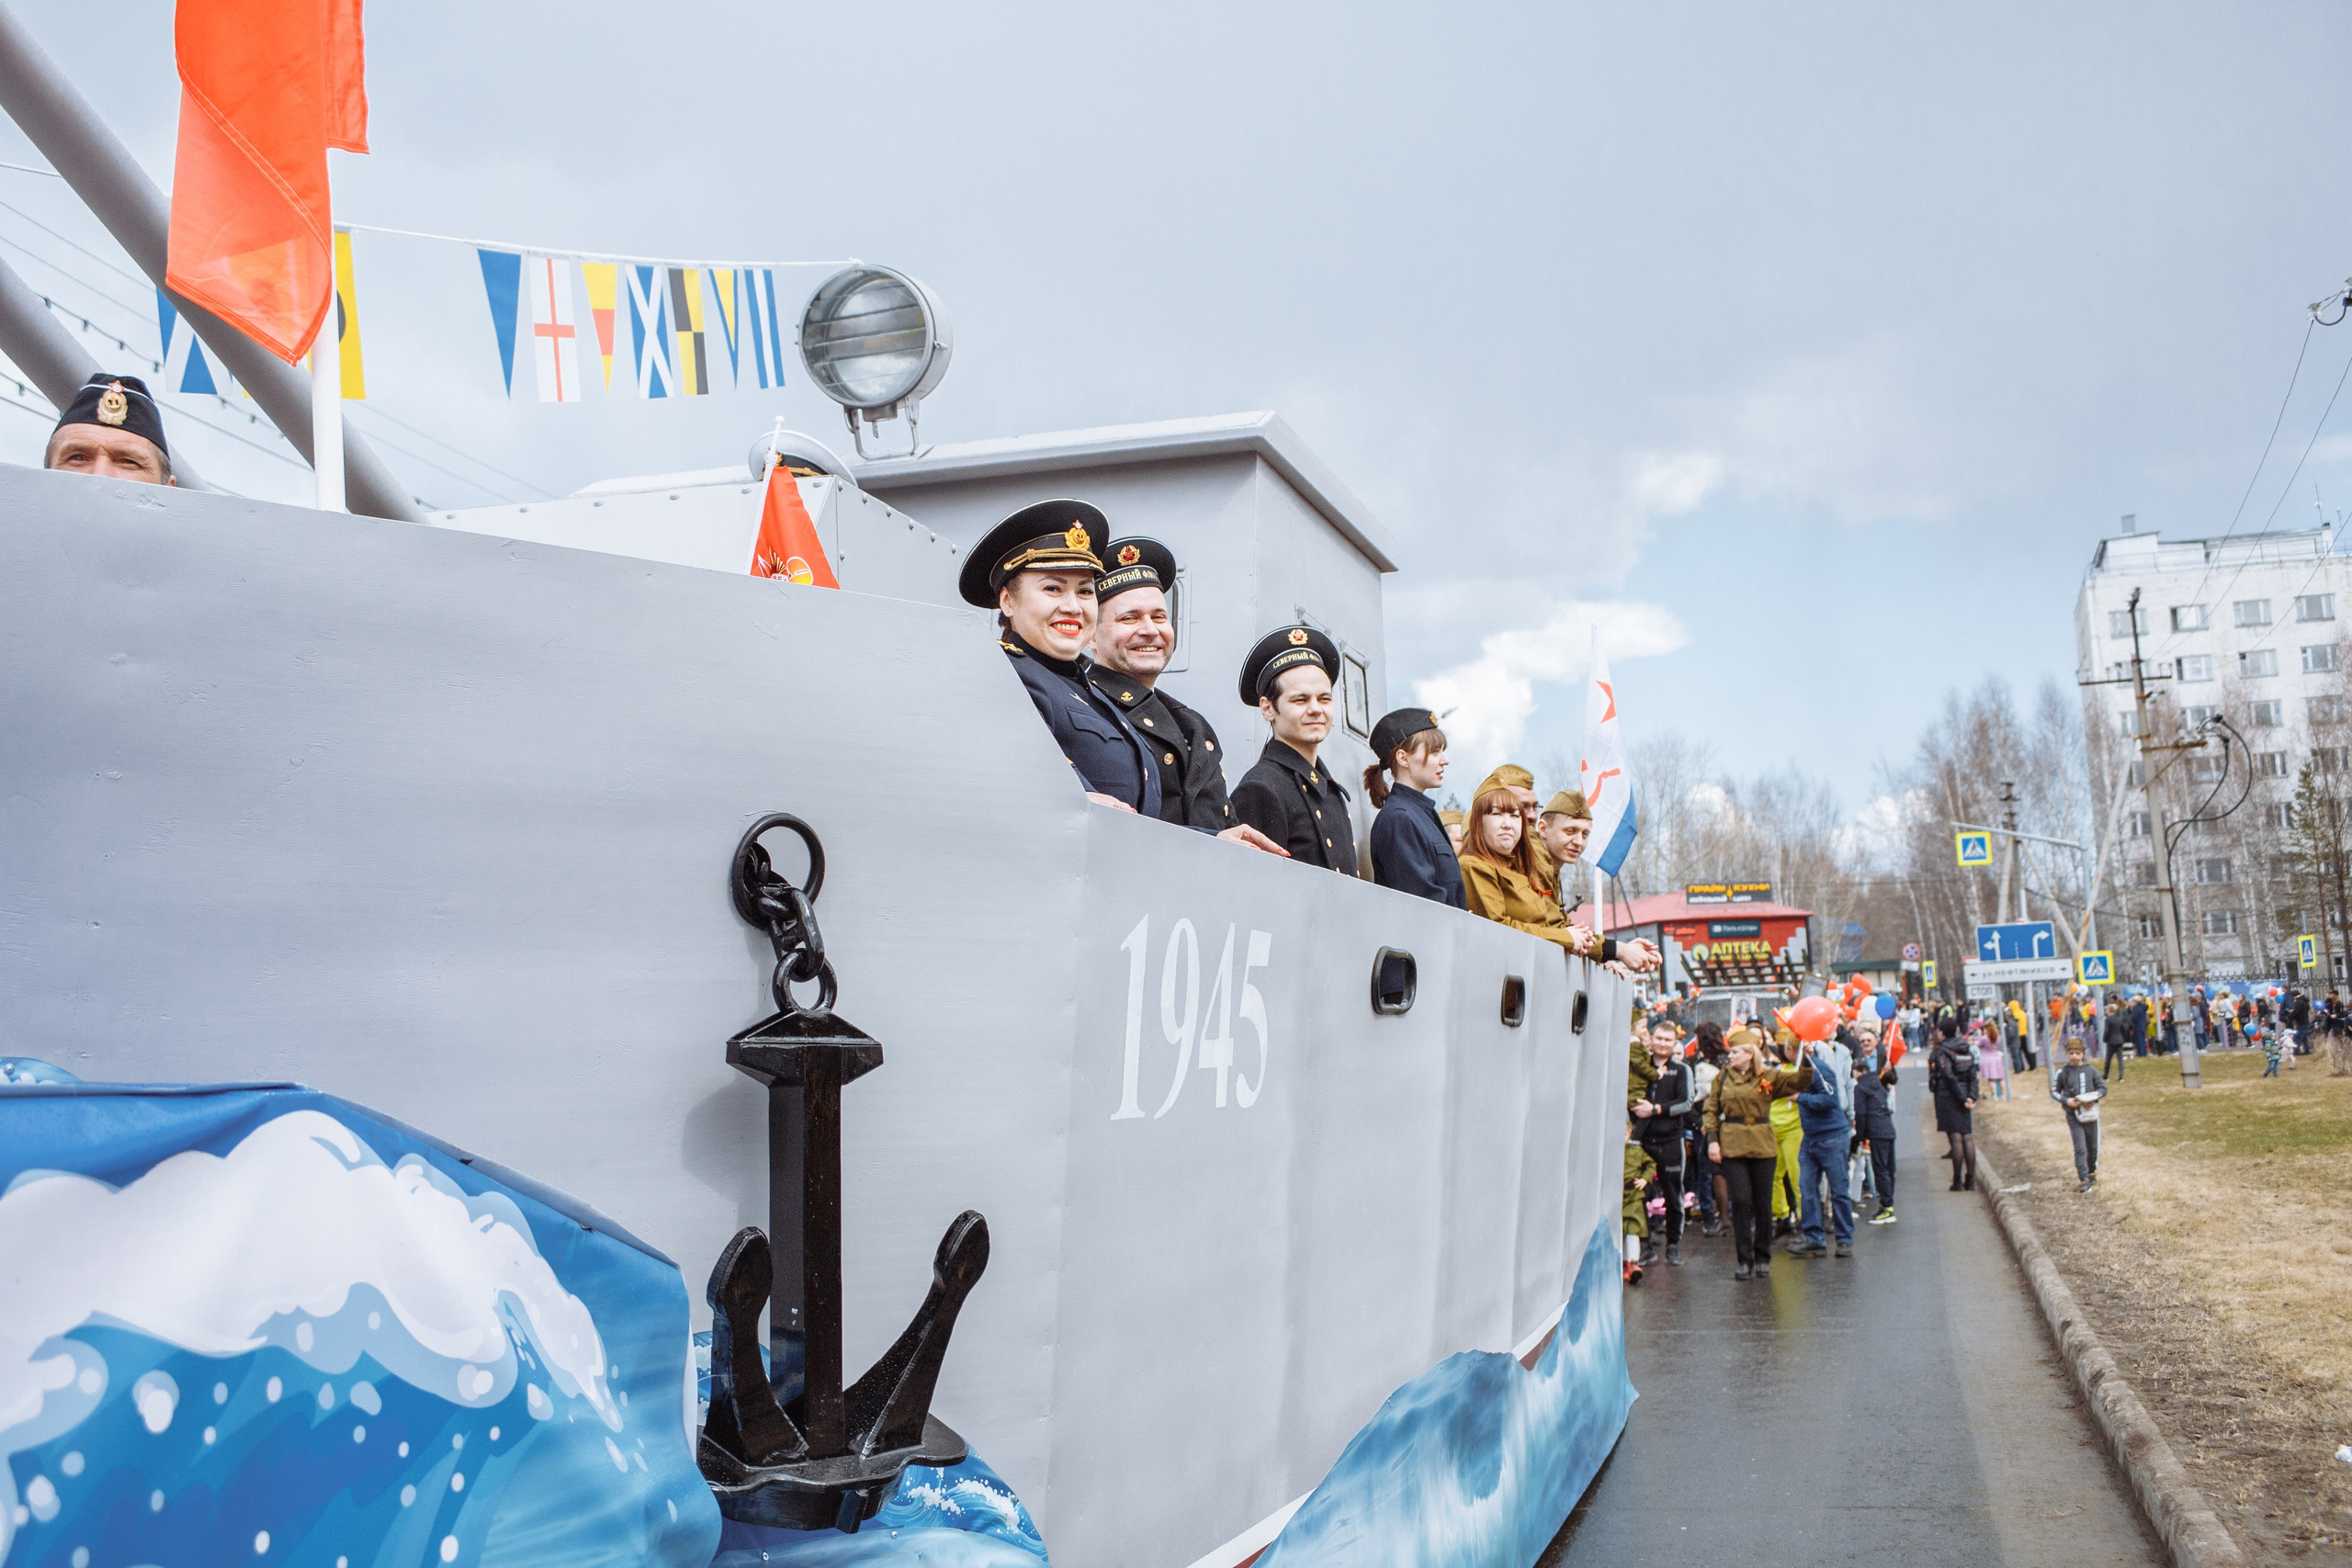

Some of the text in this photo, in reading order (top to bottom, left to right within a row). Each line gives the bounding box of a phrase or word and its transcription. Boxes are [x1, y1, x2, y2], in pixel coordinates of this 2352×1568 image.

[1098, 569, 1142, 592] СЕВЕРНЫЙ
[1272, 651, 1309, 669] СЕВЕРНЫЙ
[1711, 941, 1773, 954] АПТЕКА
[1971, 987, 1993, 997] СТОП
[1110, 913, 1272, 1121] 1945
